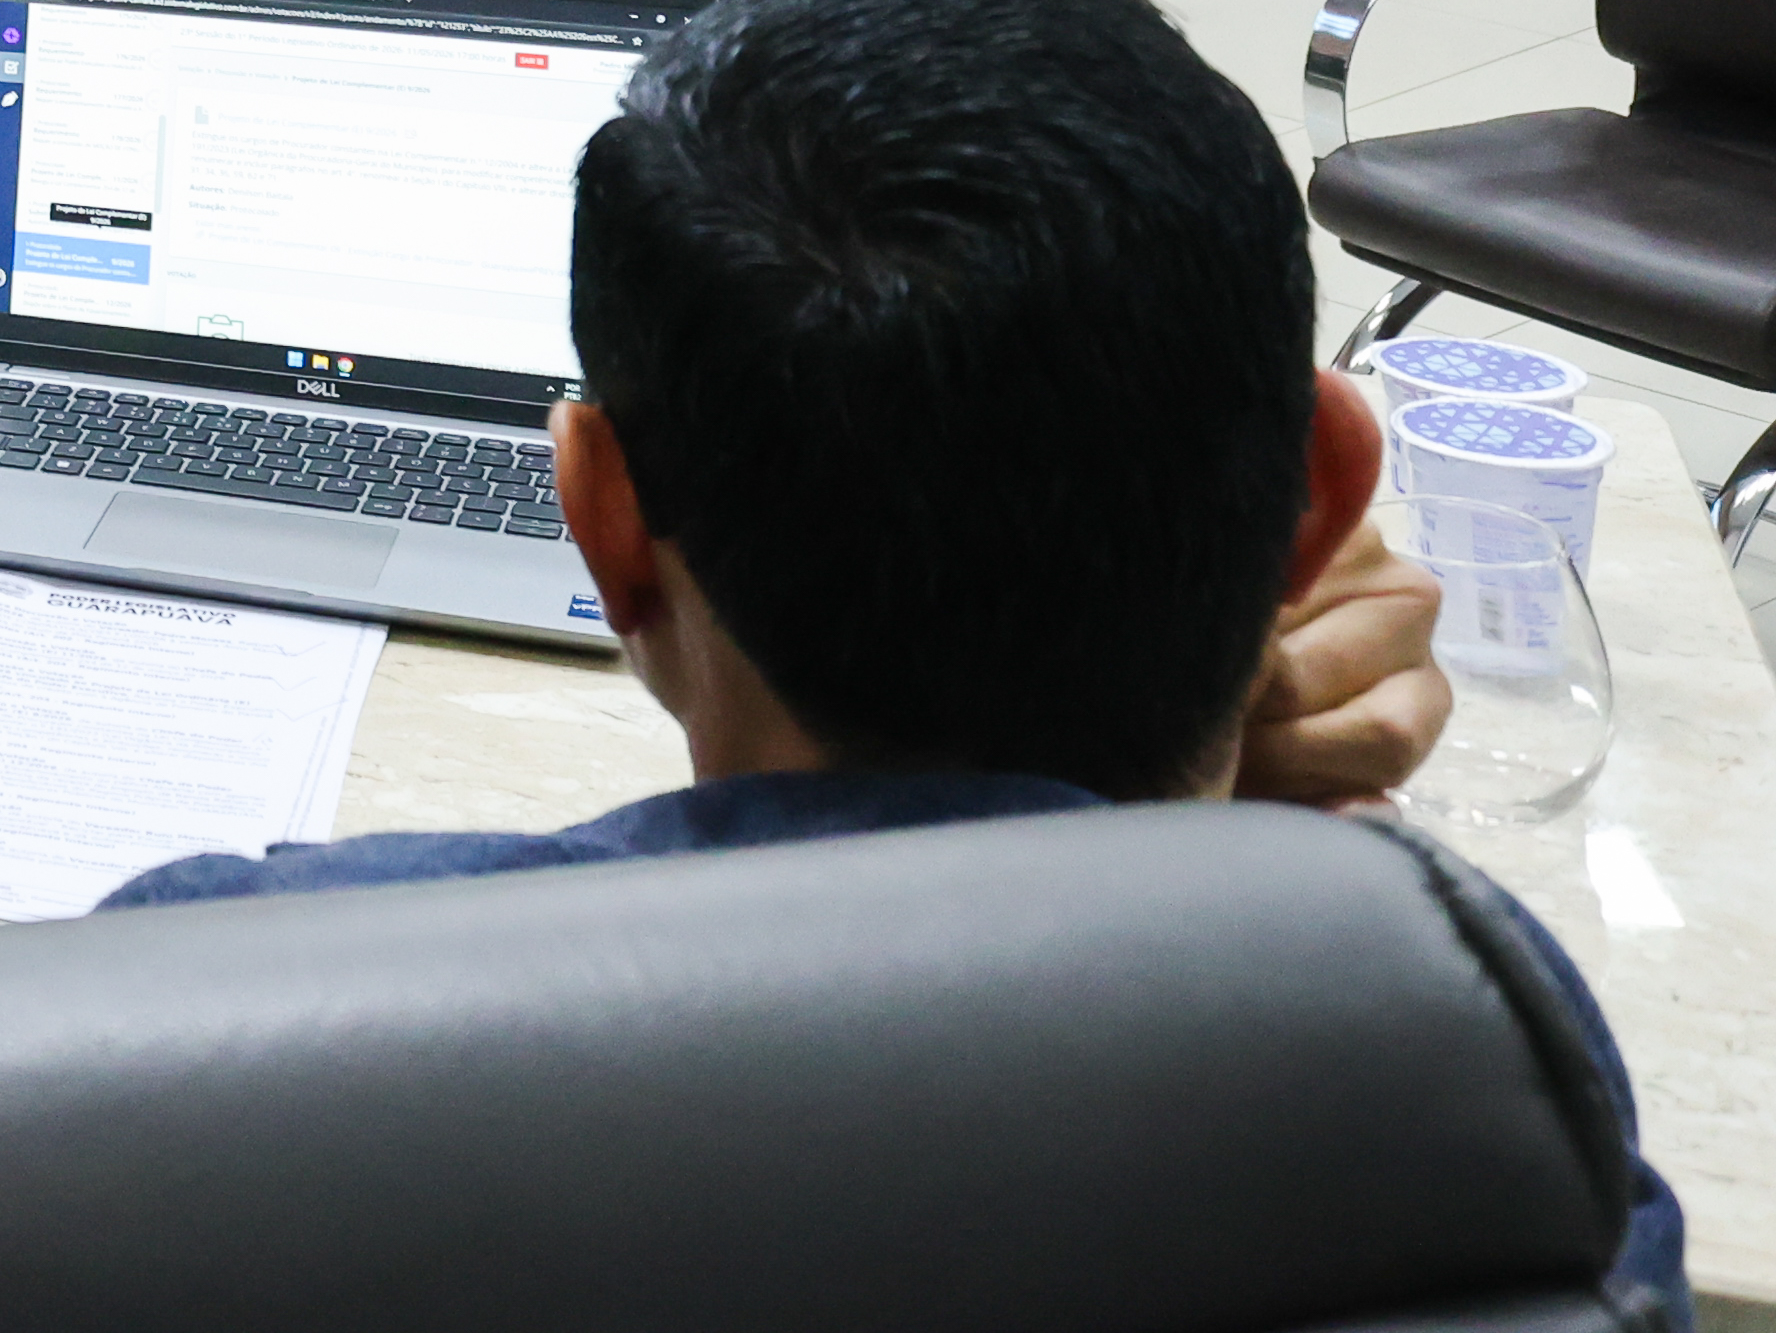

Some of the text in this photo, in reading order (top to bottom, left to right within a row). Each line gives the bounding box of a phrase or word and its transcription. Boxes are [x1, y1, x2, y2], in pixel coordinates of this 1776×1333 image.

[297, 379, 341, 398] DELL
[46, 598, 234, 626] GUARAPUAVA
[48, 592, 237, 620] PODER LEGISLATIVO
